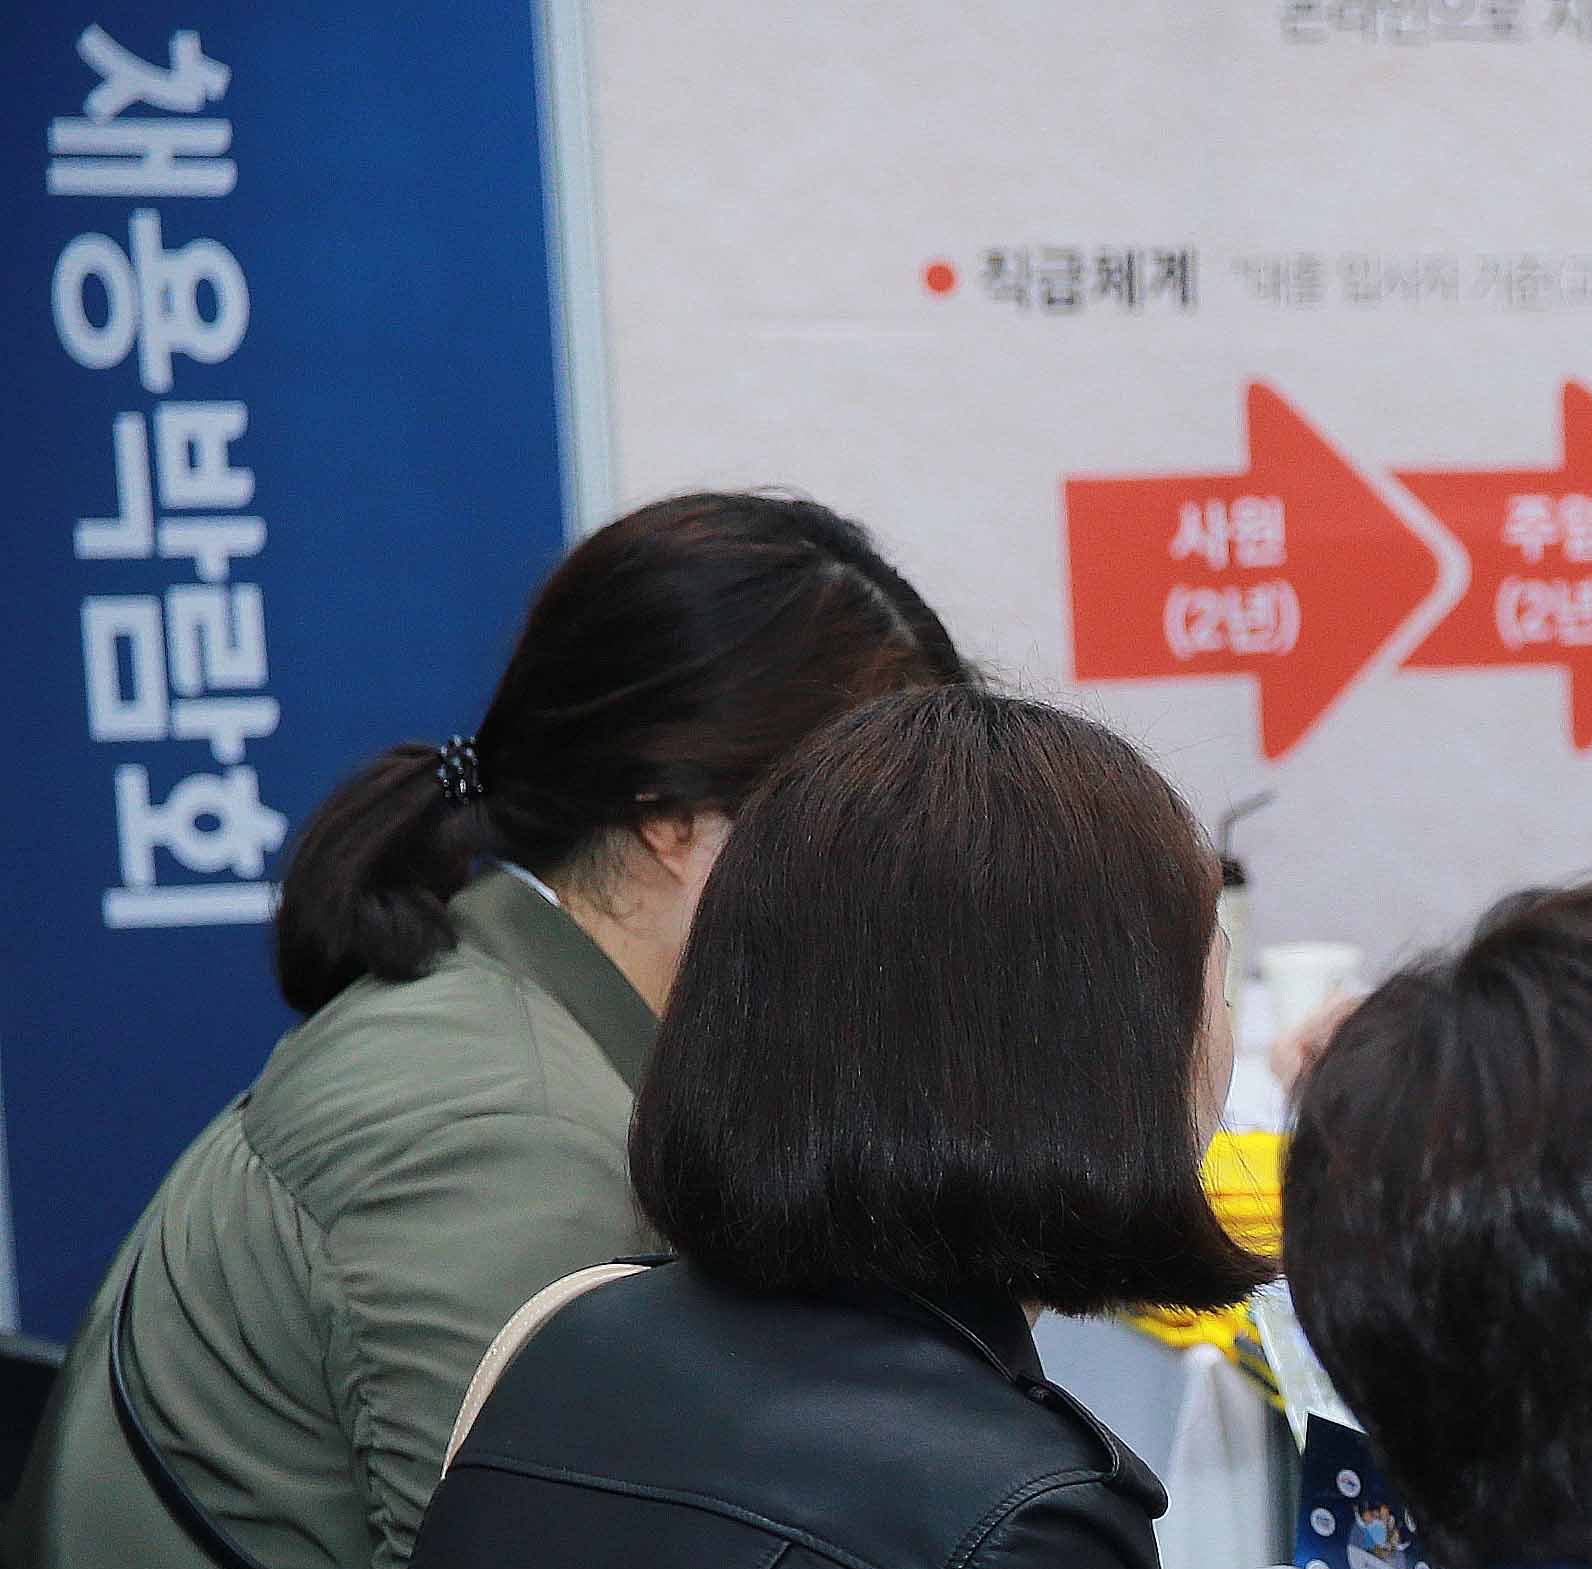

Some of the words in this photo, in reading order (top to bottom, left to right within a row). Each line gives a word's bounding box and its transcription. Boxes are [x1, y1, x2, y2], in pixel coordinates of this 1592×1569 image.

[980, 246, 1198, 313] 직급체계
[46, 22, 289, 929] 채용박람회
[1169, 496, 1287, 571] 사원
[1164, 577, 1301, 660] (2년)
